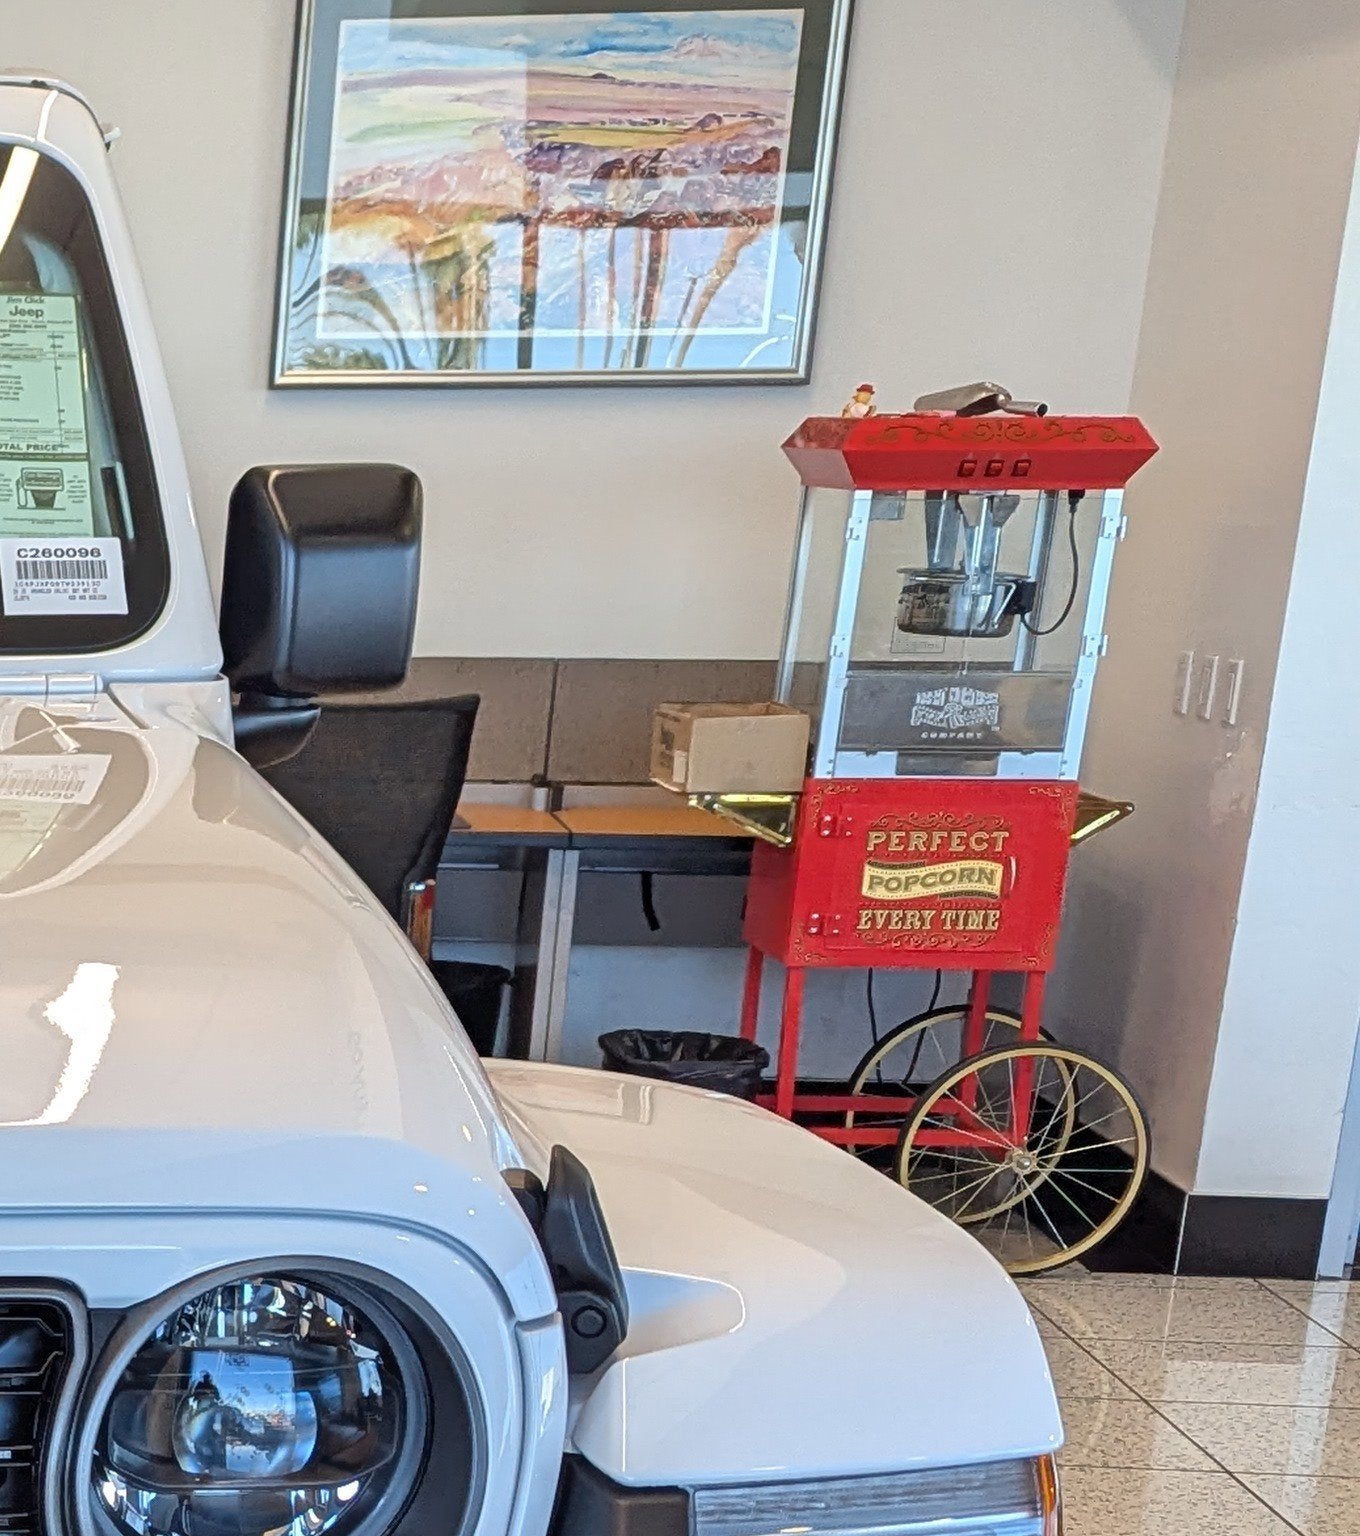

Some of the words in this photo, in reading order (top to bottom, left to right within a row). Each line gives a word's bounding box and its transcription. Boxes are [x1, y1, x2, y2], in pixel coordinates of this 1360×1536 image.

[9, 305, 44, 318] Jeep
[26, 443, 58, 452] PRICE
[866, 831, 1009, 852] PERFECT
[867, 866, 997, 894] POPCORN
[856, 909, 936, 930] EVERY
[940, 909, 1000, 930] TIME
